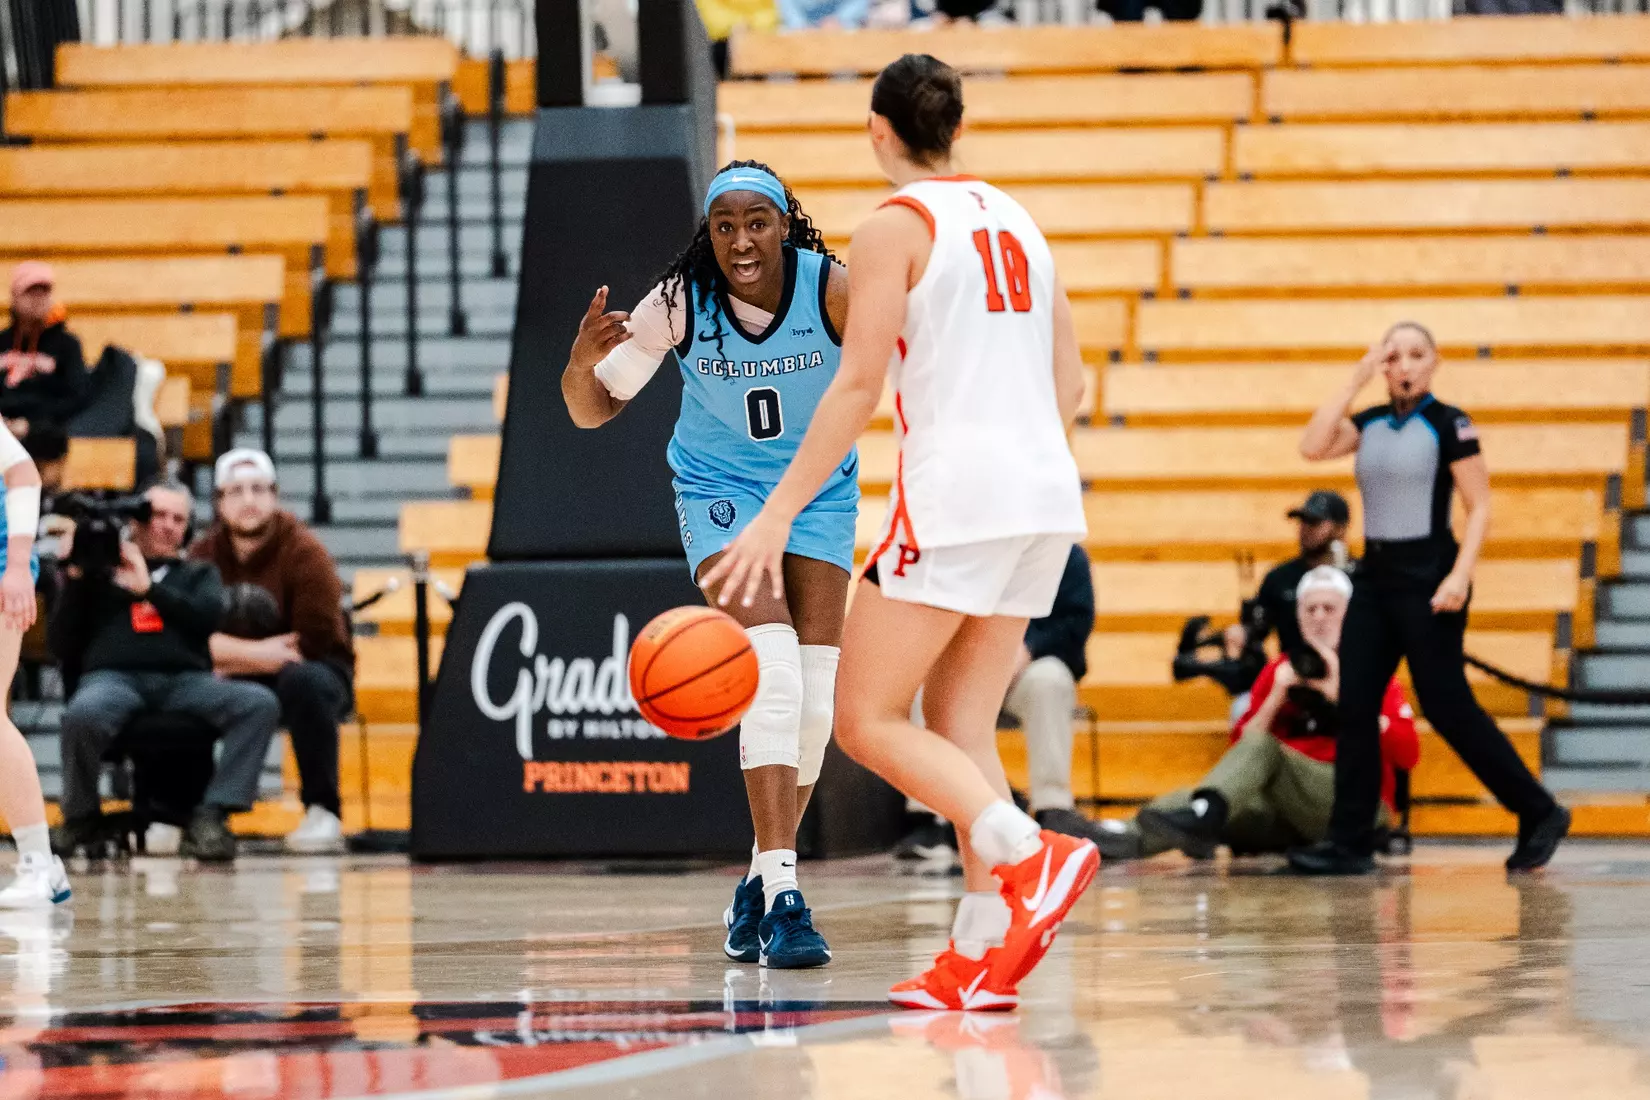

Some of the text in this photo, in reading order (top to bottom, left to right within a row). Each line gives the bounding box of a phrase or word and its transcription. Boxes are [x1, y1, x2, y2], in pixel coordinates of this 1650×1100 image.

[972, 227, 1033, 313] 10
[791, 328, 806, 338] Ivy
[697, 350, 823, 378] COLUMBIA
[744, 386, 785, 442] 0
[893, 543, 921, 578] P
[471, 602, 640, 760] Grad
[548, 718, 578, 740] BY
[523, 761, 691, 794] PRINCETON
